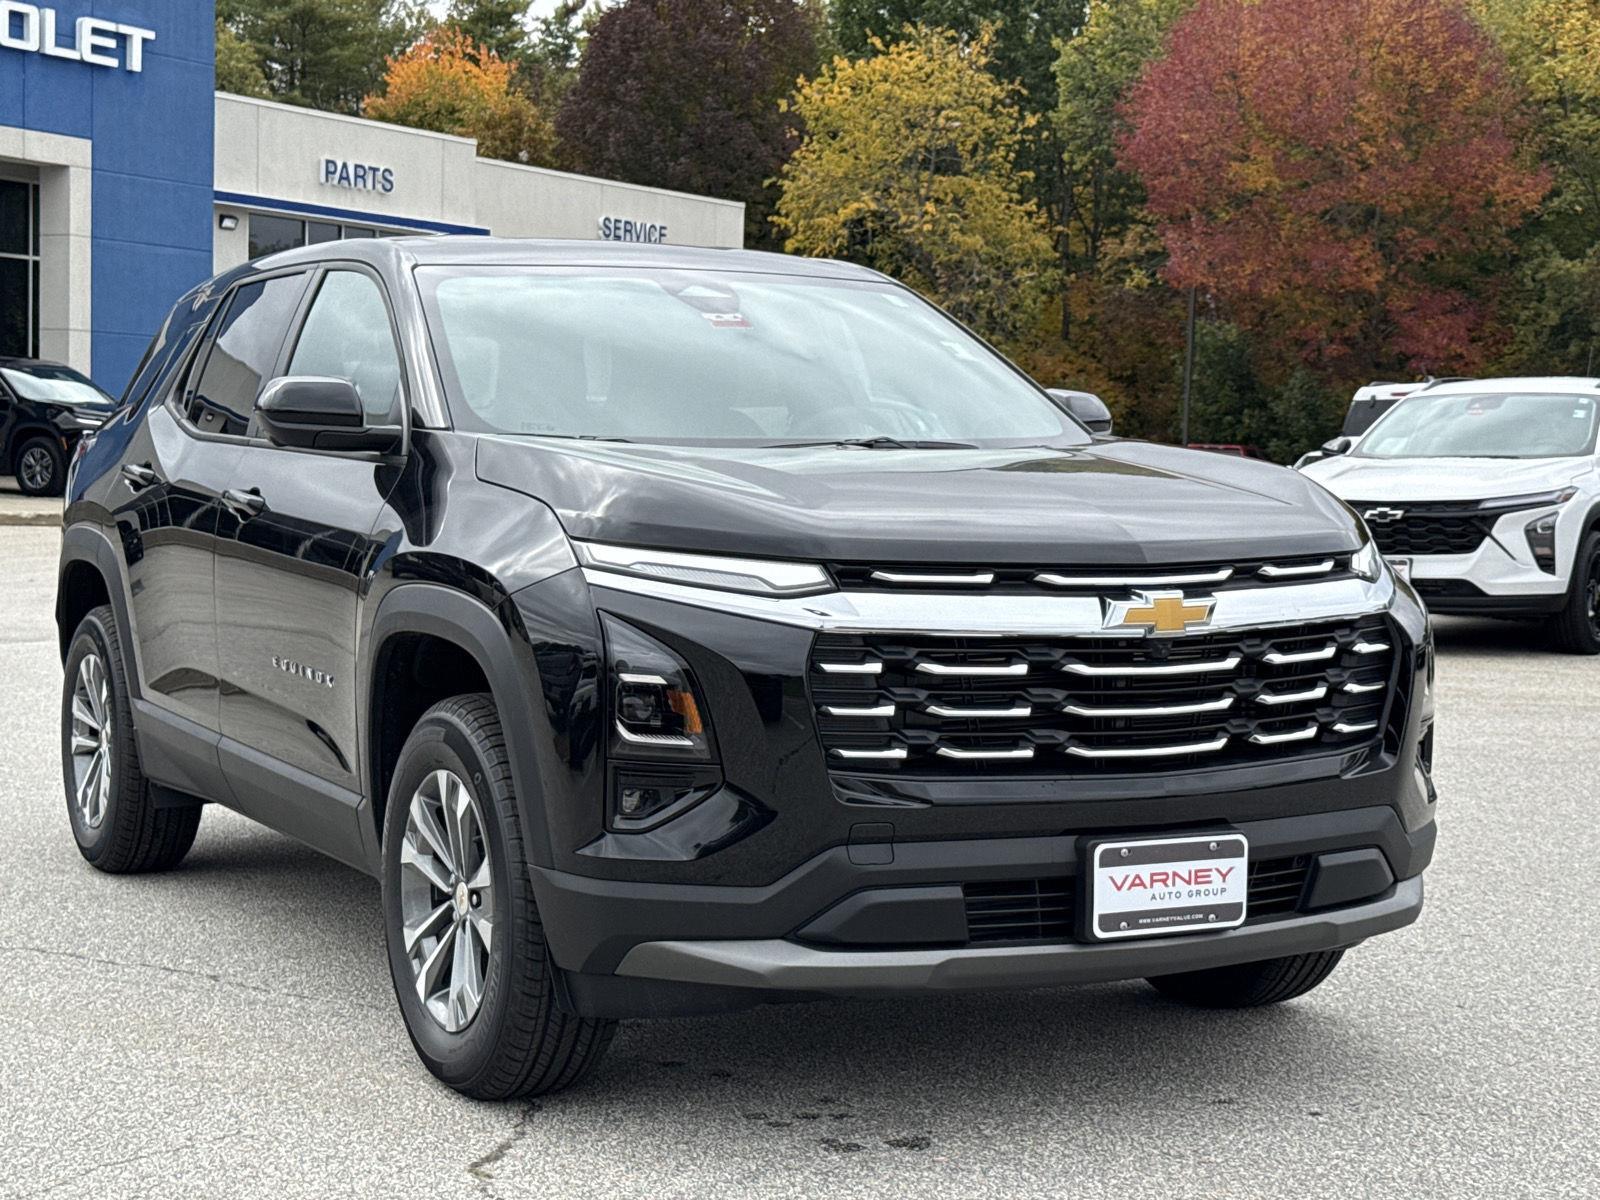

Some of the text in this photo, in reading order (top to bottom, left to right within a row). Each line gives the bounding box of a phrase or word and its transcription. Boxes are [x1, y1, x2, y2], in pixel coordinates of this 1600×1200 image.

[322, 158, 394, 193] PARTS
[600, 216, 668, 243] SERVICE
[1108, 866, 1235, 892] VARNEY
[1150, 887, 1227, 901] AUTO GROUP
